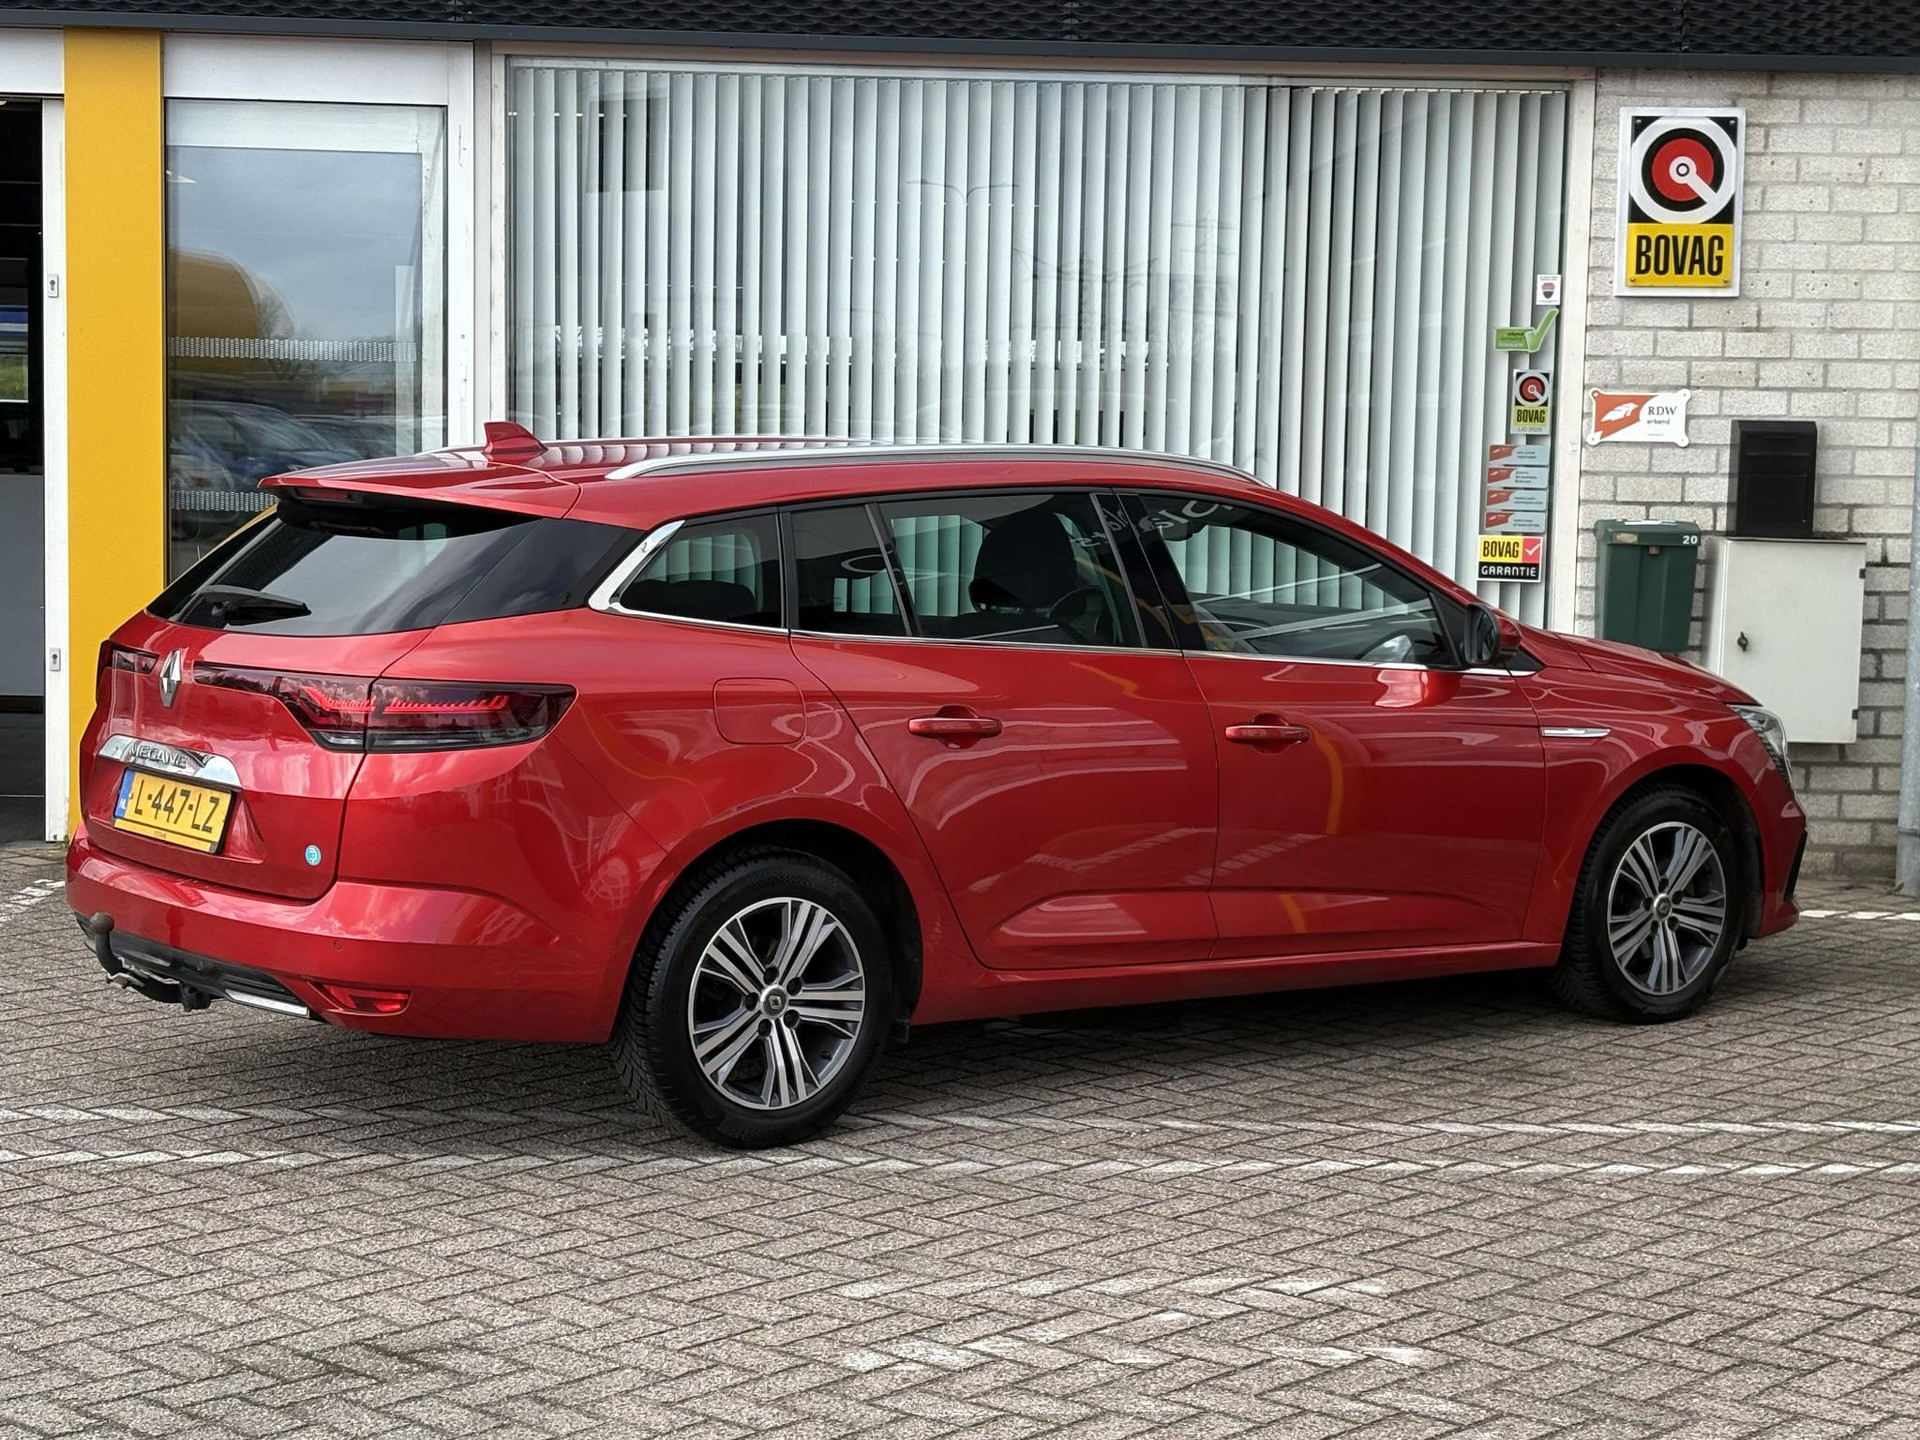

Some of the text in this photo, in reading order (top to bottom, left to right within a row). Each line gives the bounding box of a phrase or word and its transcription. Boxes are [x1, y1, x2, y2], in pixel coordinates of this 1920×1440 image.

[1635, 234, 1724, 276] BOVAG
[1516, 409, 1546, 423] BOVAG
[1647, 406, 1678, 416] RDW
[1682, 535, 1698, 545] 20
[1483, 540, 1520, 558] BOVAG
[1481, 565, 1537, 577] GARANTIE
[134, 779, 220, 834] L-447-LZ
